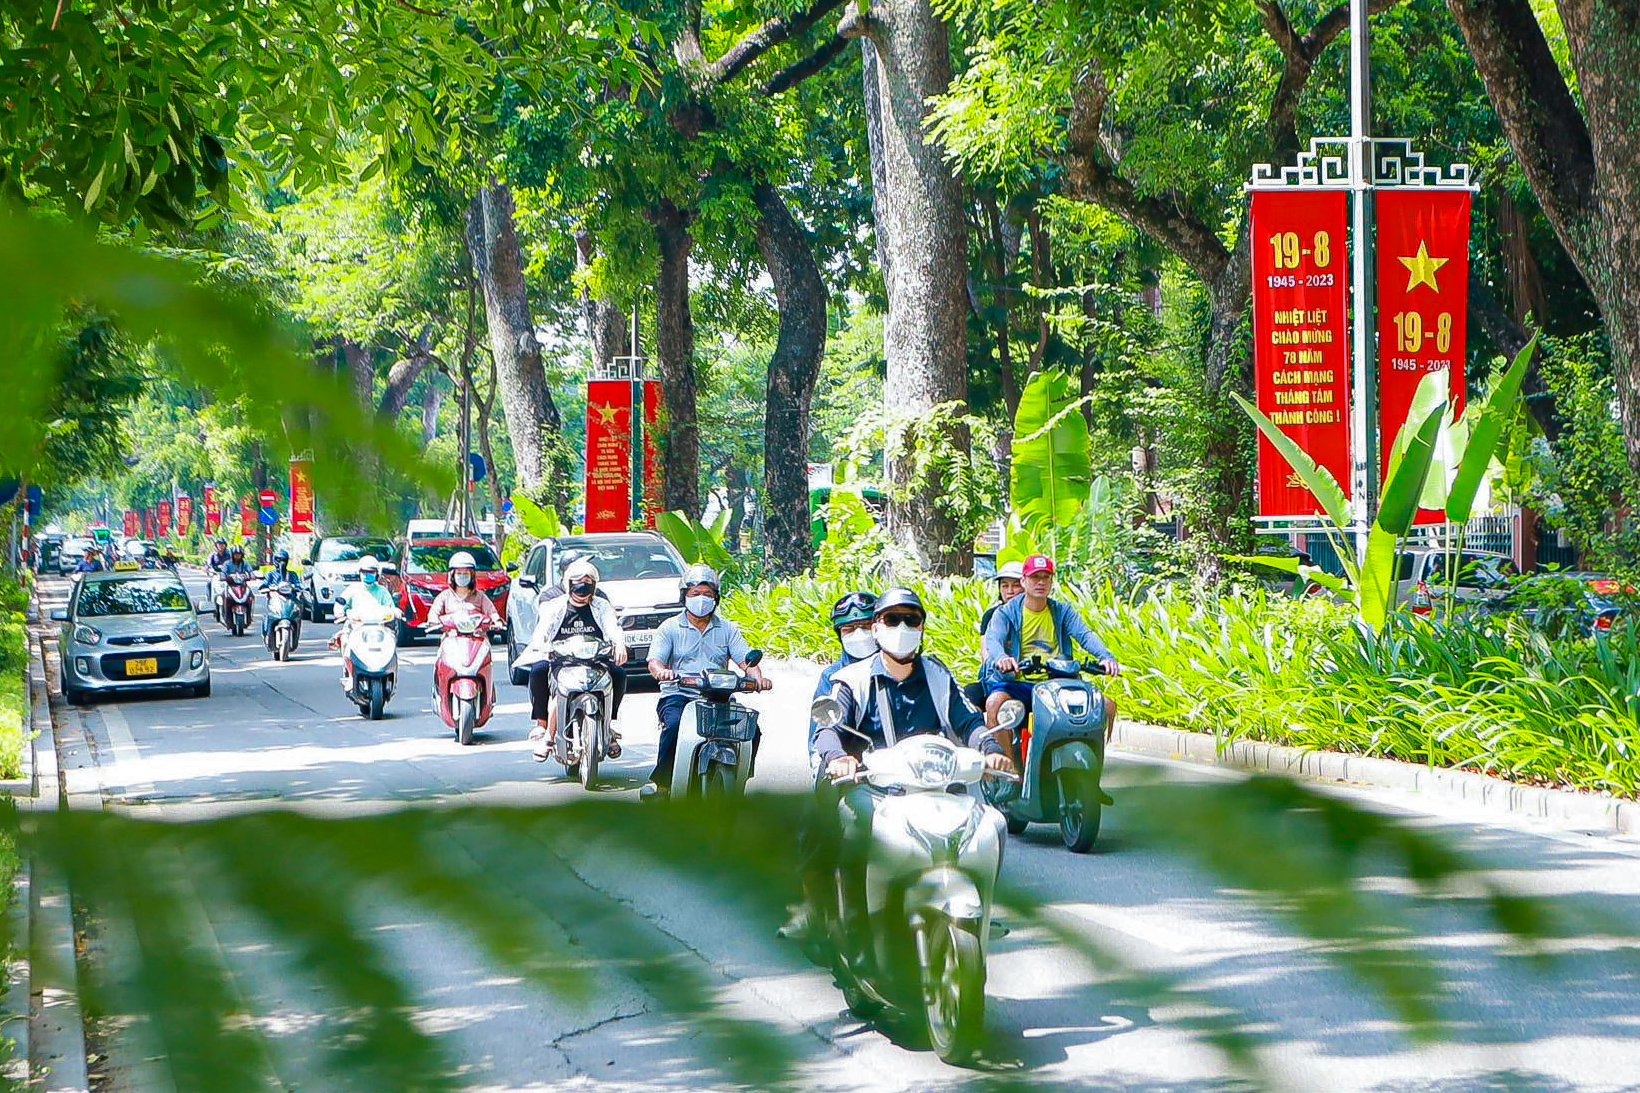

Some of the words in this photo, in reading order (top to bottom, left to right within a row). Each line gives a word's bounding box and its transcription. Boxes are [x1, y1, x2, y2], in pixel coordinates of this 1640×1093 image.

[1269, 230, 1330, 269] 19-8
[1267, 275, 1296, 288] 1945
[1306, 274, 1334, 287] 2023
[1274, 308, 1305, 327] NHIỆT
[1307, 309, 1328, 327] LIỆT
[1271, 328, 1300, 345] CHÀO
[1301, 327, 1333, 344] MỪNG
[1393, 311, 1452, 353] 19-8
[1283, 351, 1297, 364] 78
[1298, 348, 1323, 364] NĂM
[1391, 357, 1417, 371] 1945
[1273, 369, 1302, 385] CÁCH
[1303, 370, 1334, 387] MẠNG
[1275, 389, 1310, 405] THÁNG
[1312, 388, 1333, 404] TÁM
[1270, 408, 1304, 425] THÀNH
[1306, 410, 1334, 424] CÔNG
